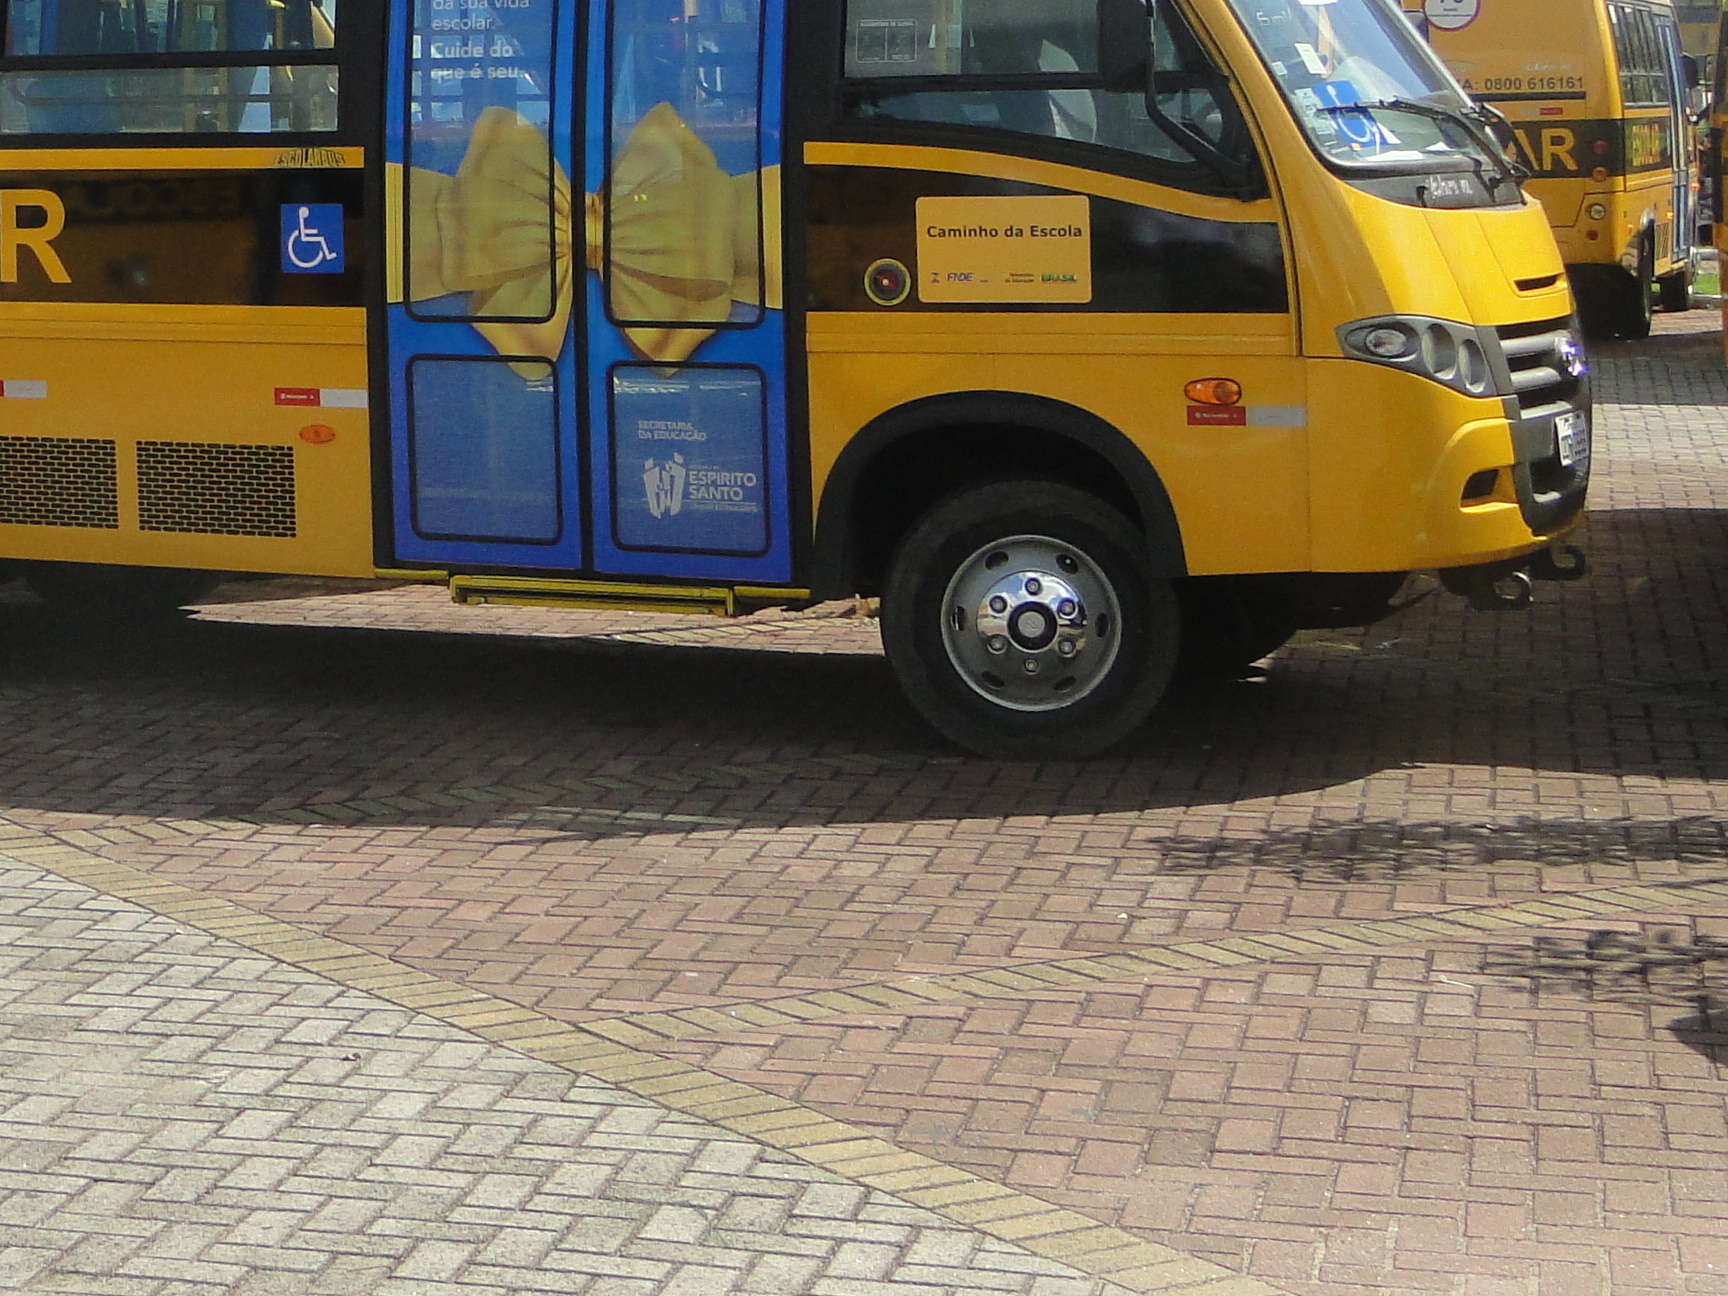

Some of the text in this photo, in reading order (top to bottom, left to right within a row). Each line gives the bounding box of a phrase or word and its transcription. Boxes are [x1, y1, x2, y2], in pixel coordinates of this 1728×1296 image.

[432, 40, 514, 58] Cuide do
[432, 67, 464, 84] que
[471, 63, 481, 79] é
[1484, 78, 1522, 91] 0800
[1527, 77, 1584, 90] 616161
[927, 224, 1083, 238] Caminho da Escola
[689, 485, 744, 501] SANTO
